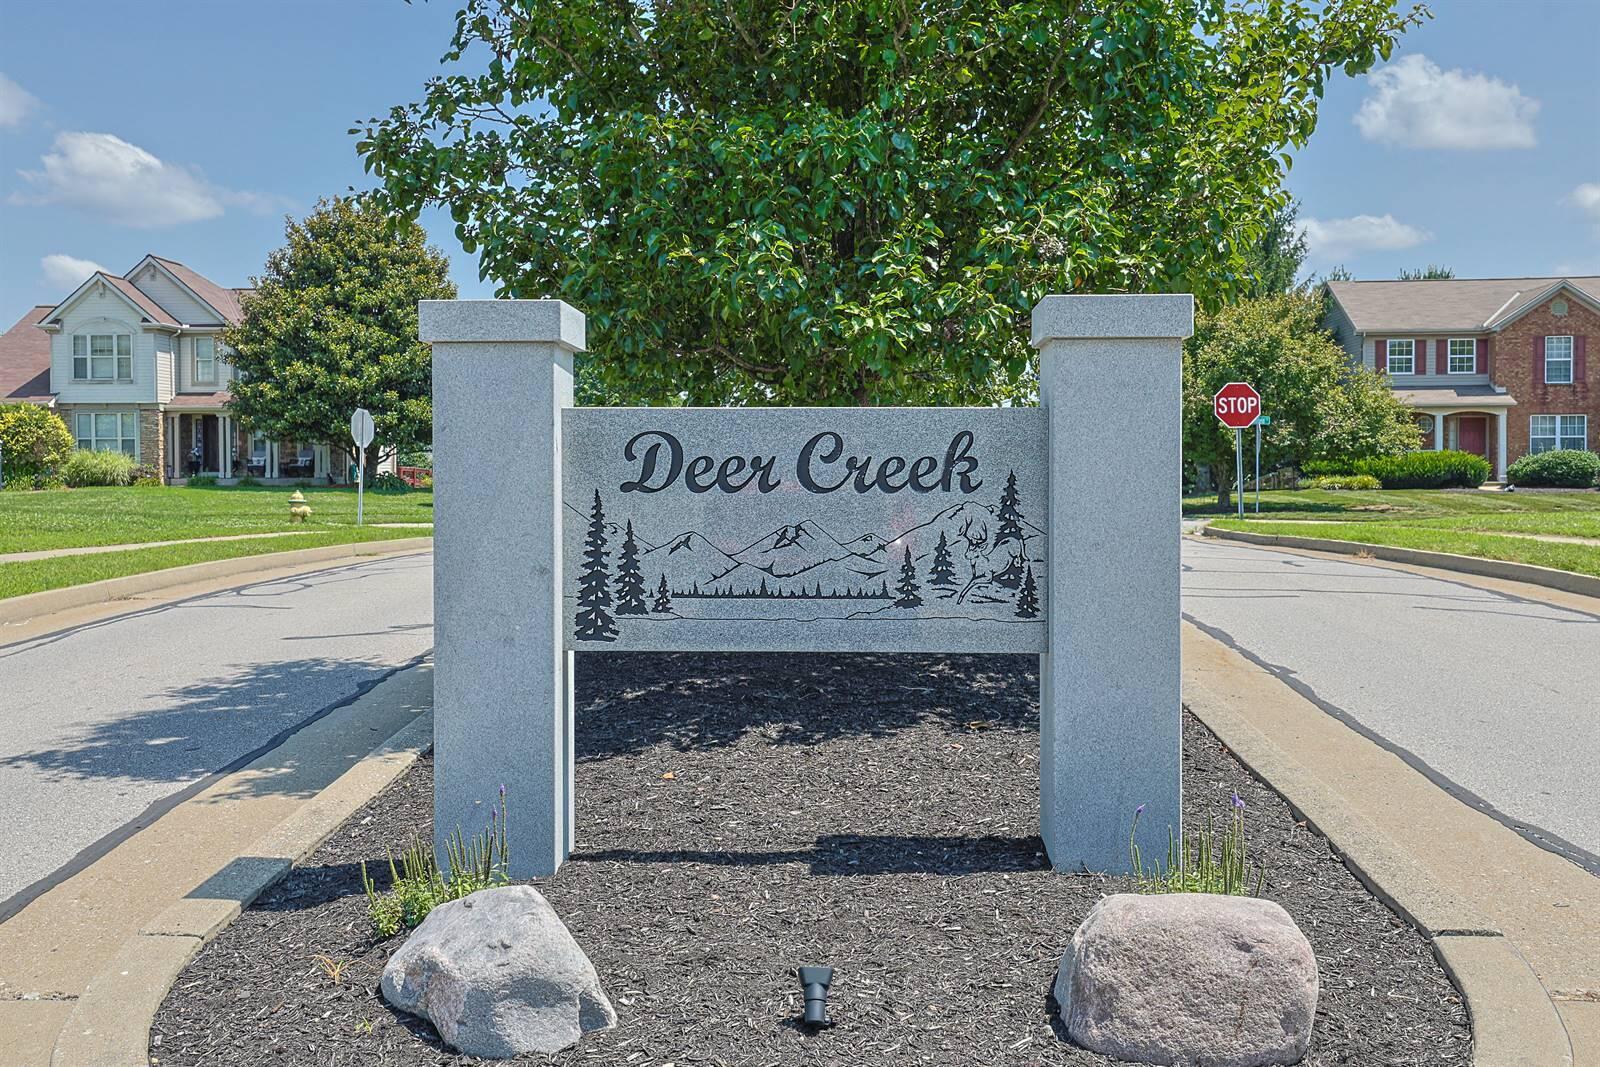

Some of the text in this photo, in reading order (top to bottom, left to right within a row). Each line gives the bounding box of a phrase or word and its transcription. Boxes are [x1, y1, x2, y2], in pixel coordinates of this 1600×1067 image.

[1218, 397, 1257, 414] STOP
[620, 430, 983, 493] Deer Creek
